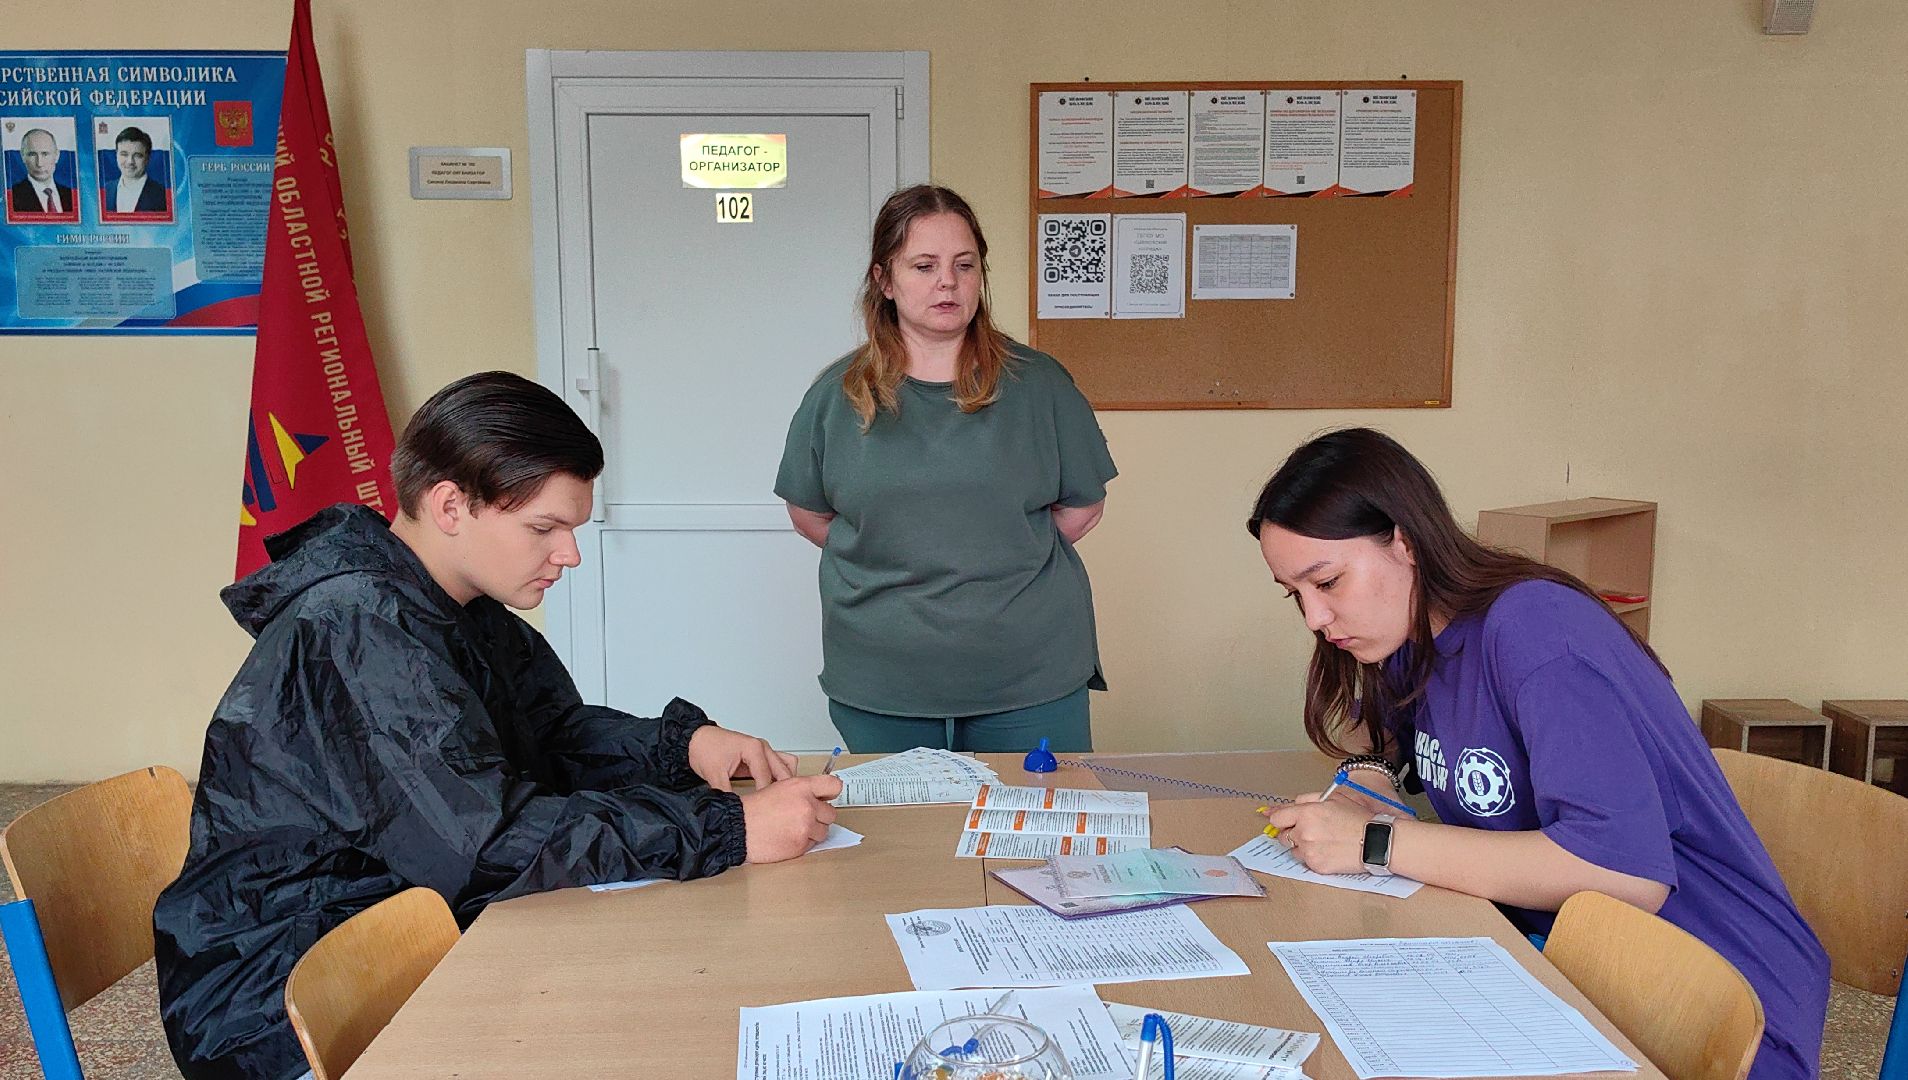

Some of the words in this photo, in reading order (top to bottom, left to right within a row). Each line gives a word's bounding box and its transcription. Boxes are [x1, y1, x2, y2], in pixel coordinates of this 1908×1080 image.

[117, 66, 238, 83] СИМВОЛИКА
[89, 90, 207, 109] ФЕДЕРАЦИИ
[702, 145, 760, 157] ПЕДАГОГ
[202, 162, 227, 172] ГЕРБ
[230, 162, 271, 172] РОССИИ
[689, 161, 780, 172] ОРГАНИЗАТОР
[718, 196, 750, 220] 102
[89, 233, 130, 244] РОССИИ
[275, 176, 332, 304] ОБЛАСТНОЙ
[310, 311, 376, 475] РЕГИОНАЛЬНЫЙ
[356, 480, 386, 516] ШТ
